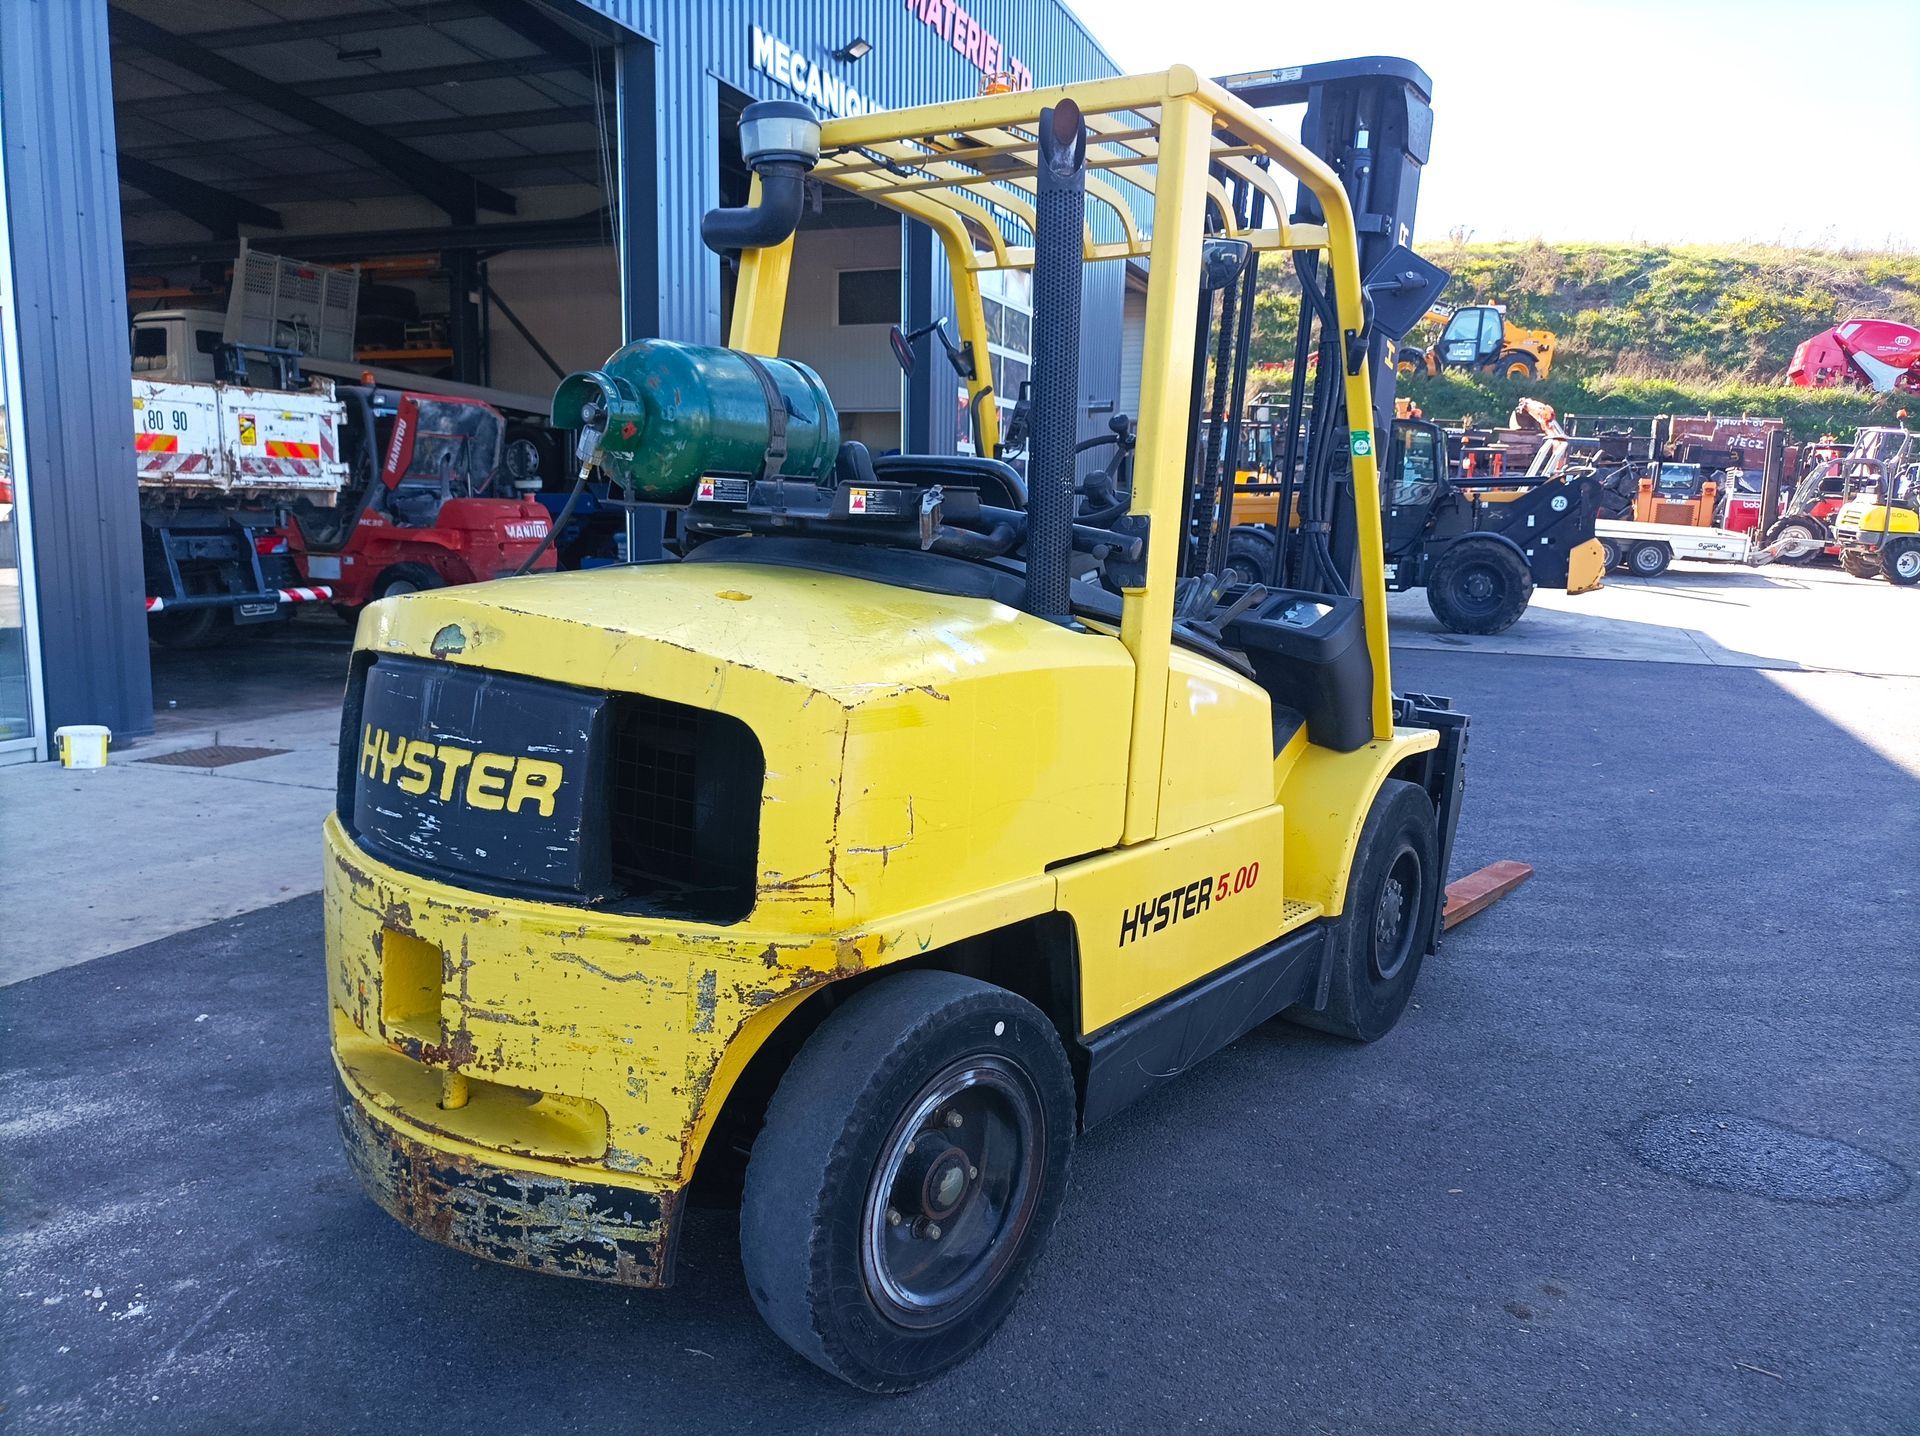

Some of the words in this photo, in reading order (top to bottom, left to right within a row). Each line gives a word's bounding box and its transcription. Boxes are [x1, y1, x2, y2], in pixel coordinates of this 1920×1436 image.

[147, 409, 164, 432] 80
[172, 409, 188, 432] 90
[386, 418, 408, 474] MANITOU
[1553, 499, 1565, 508] 25
[504, 524, 549, 539] MANITOU
[359, 723, 564, 818] HYSTER
[1118, 876, 1214, 949] HYSTER
[1214, 861, 1260, 902] 5.00
